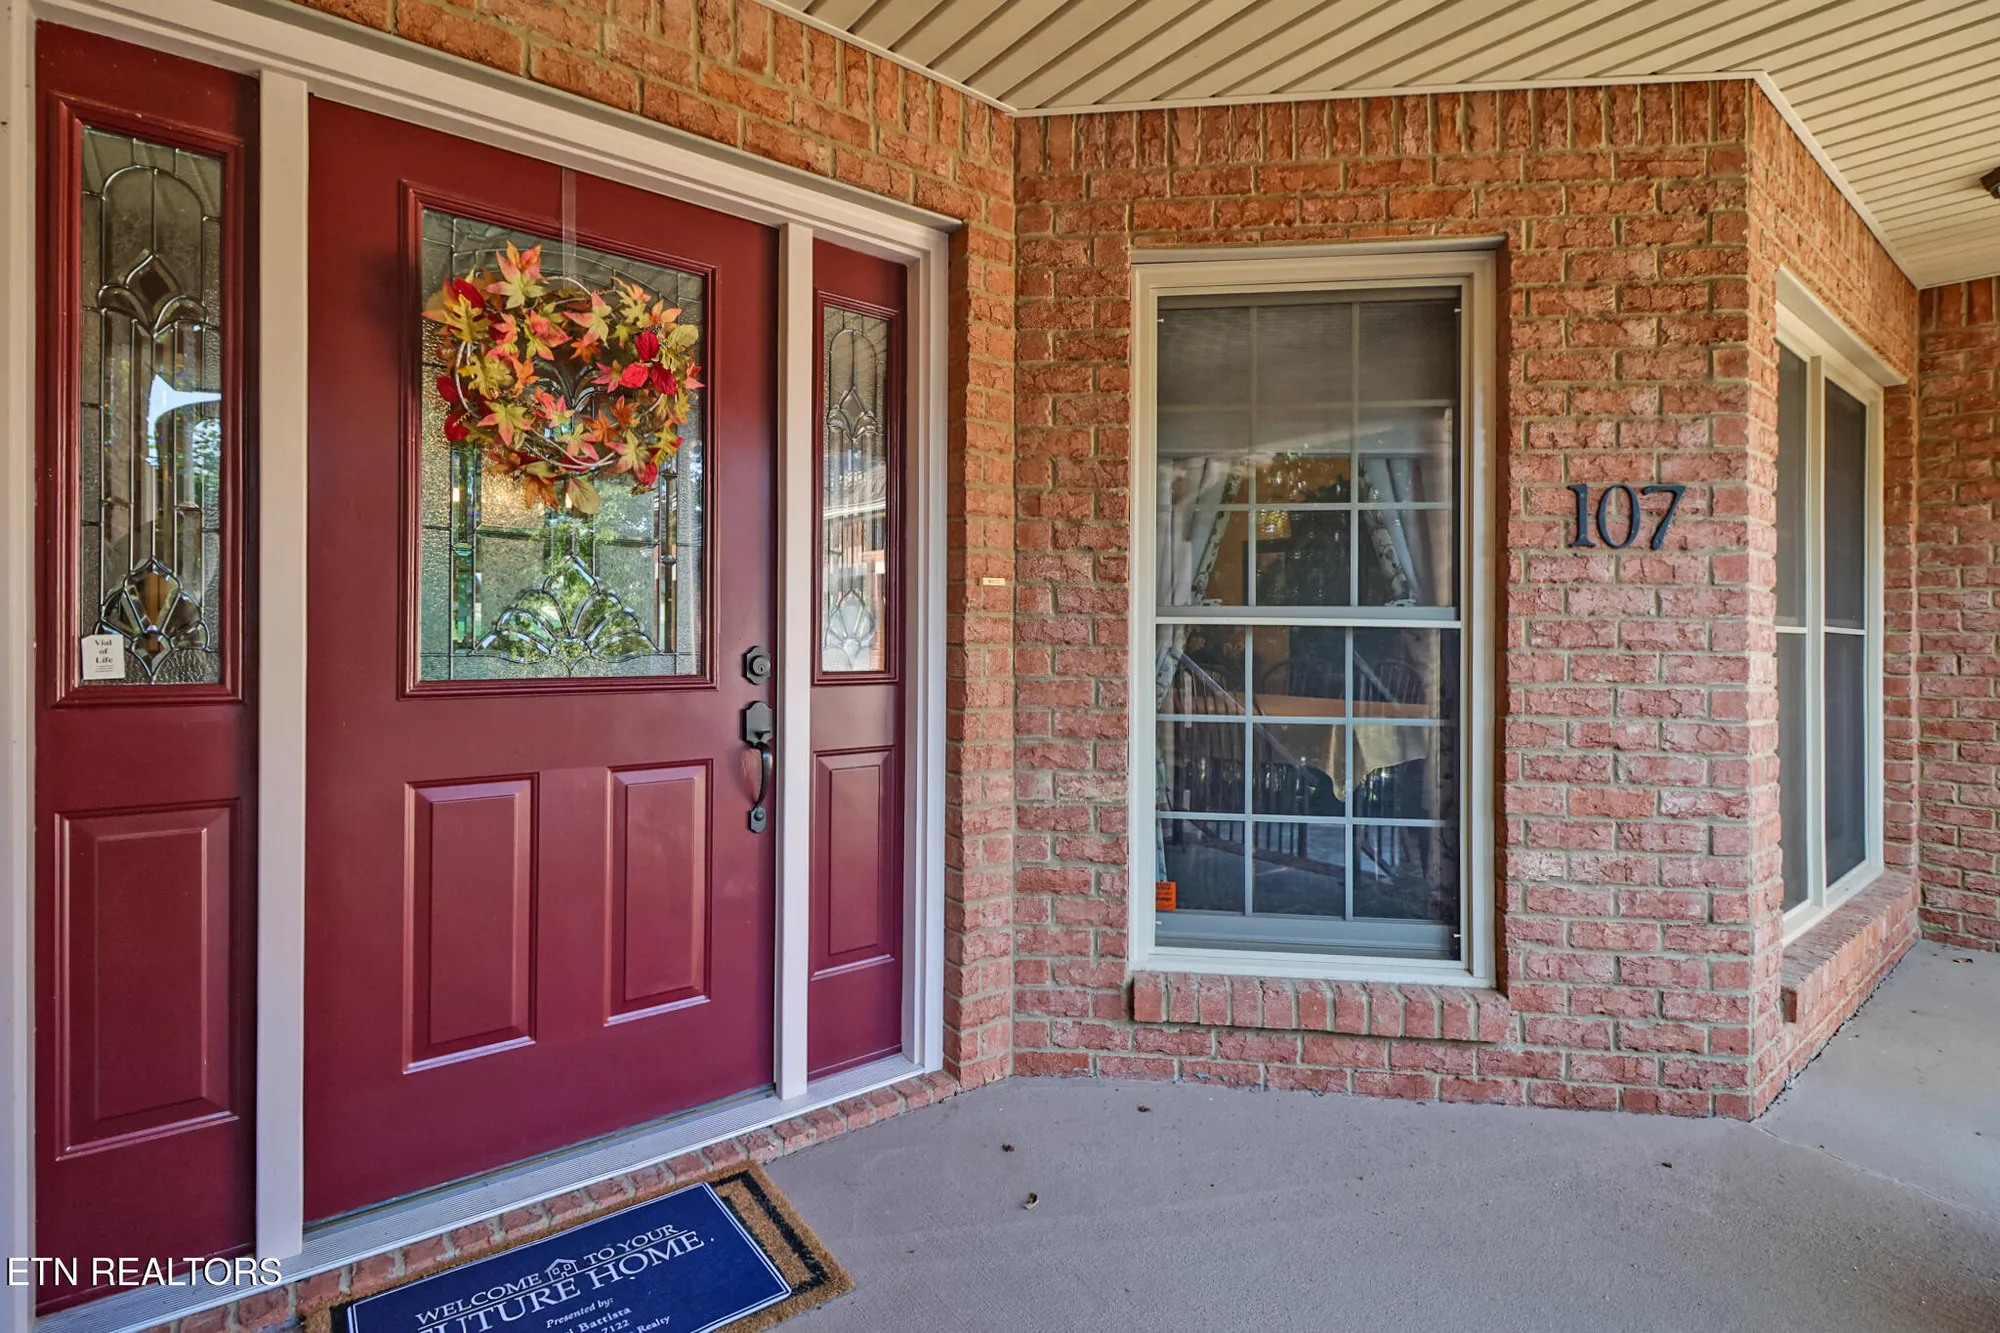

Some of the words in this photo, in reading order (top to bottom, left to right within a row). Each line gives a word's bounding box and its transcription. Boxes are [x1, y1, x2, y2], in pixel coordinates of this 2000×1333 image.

[1566, 483, 1687, 551] 107
[95, 656, 114, 664] Life
[415, 1273, 542, 1325] WELCOME
[583, 1248, 615, 1266] TO
[616, 1224, 679, 1251] YOUR
[418, 1277, 581, 1333] UTURE
[546, 1302, 596, 1329] Presented
[597, 1297, 614, 1309] by:
